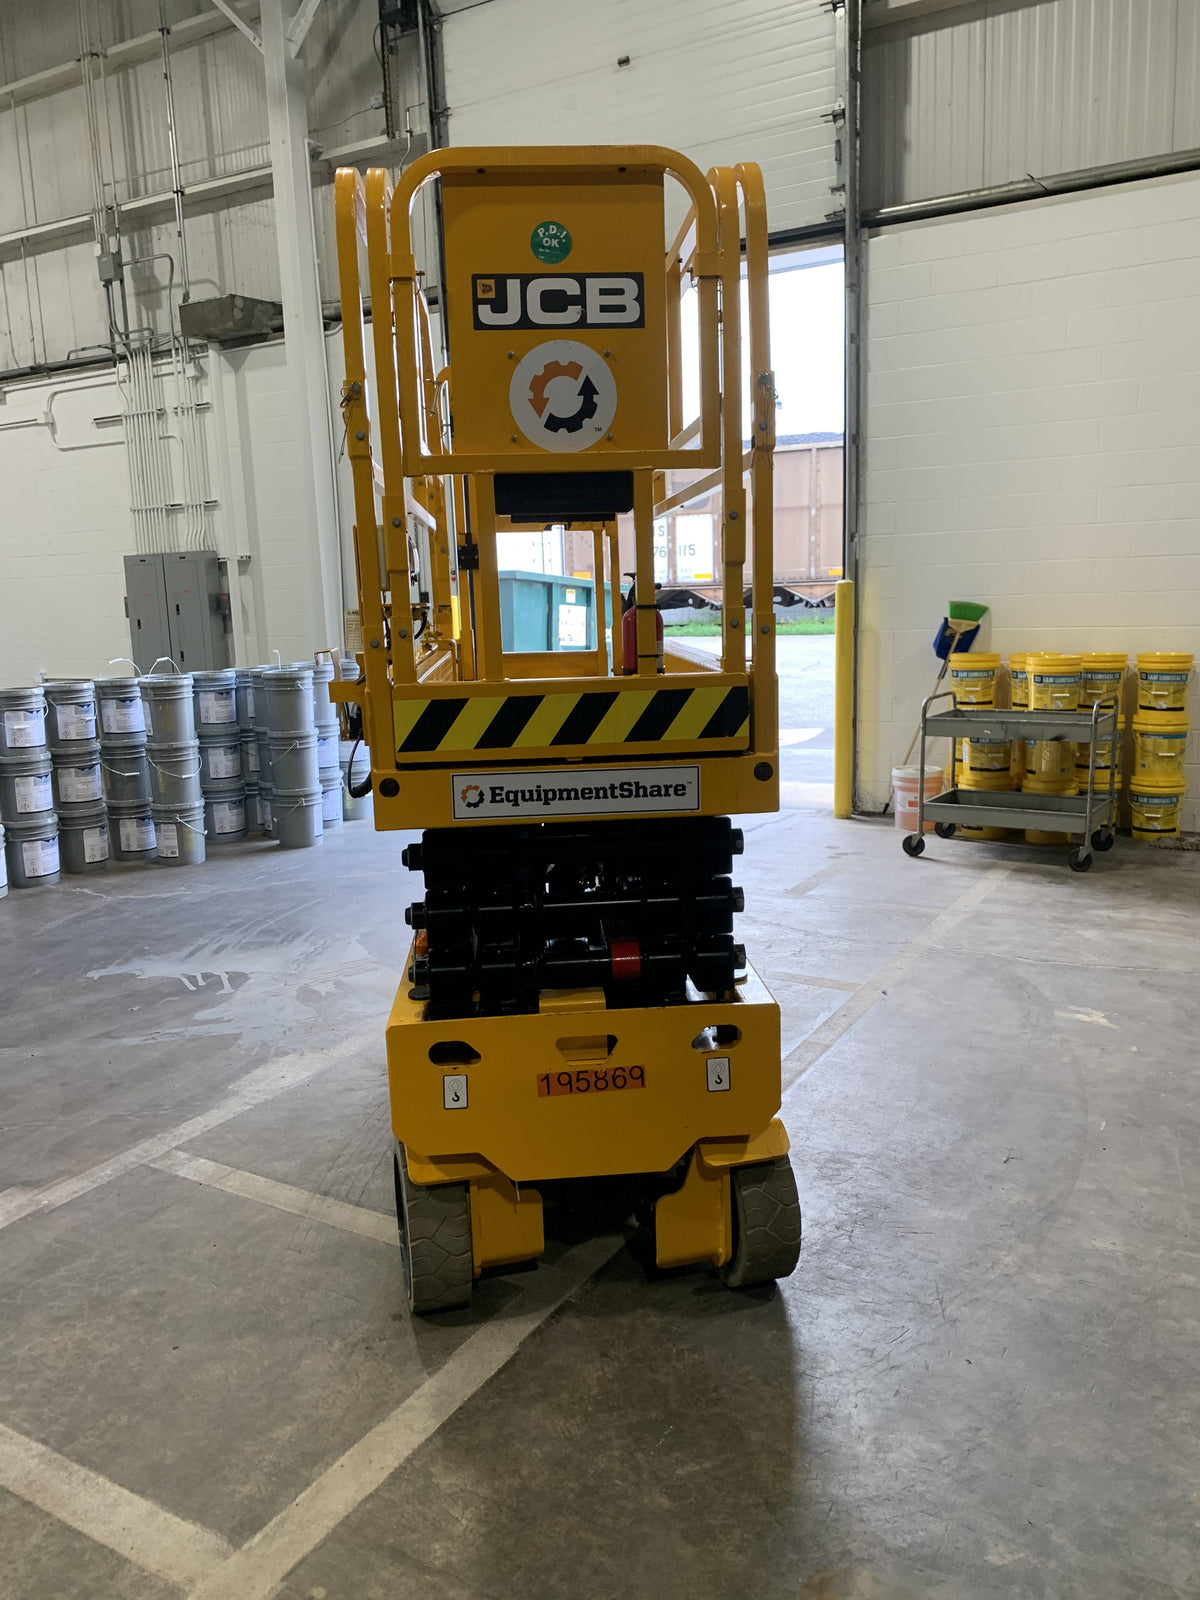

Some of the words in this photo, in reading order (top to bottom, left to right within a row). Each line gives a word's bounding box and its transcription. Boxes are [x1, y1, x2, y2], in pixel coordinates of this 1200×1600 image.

[542, 237, 560, 248] OK
[477, 277, 641, 326] JCB
[489, 781, 687, 807] EquipmentShare
[540, 1065, 645, 1096] 195869
